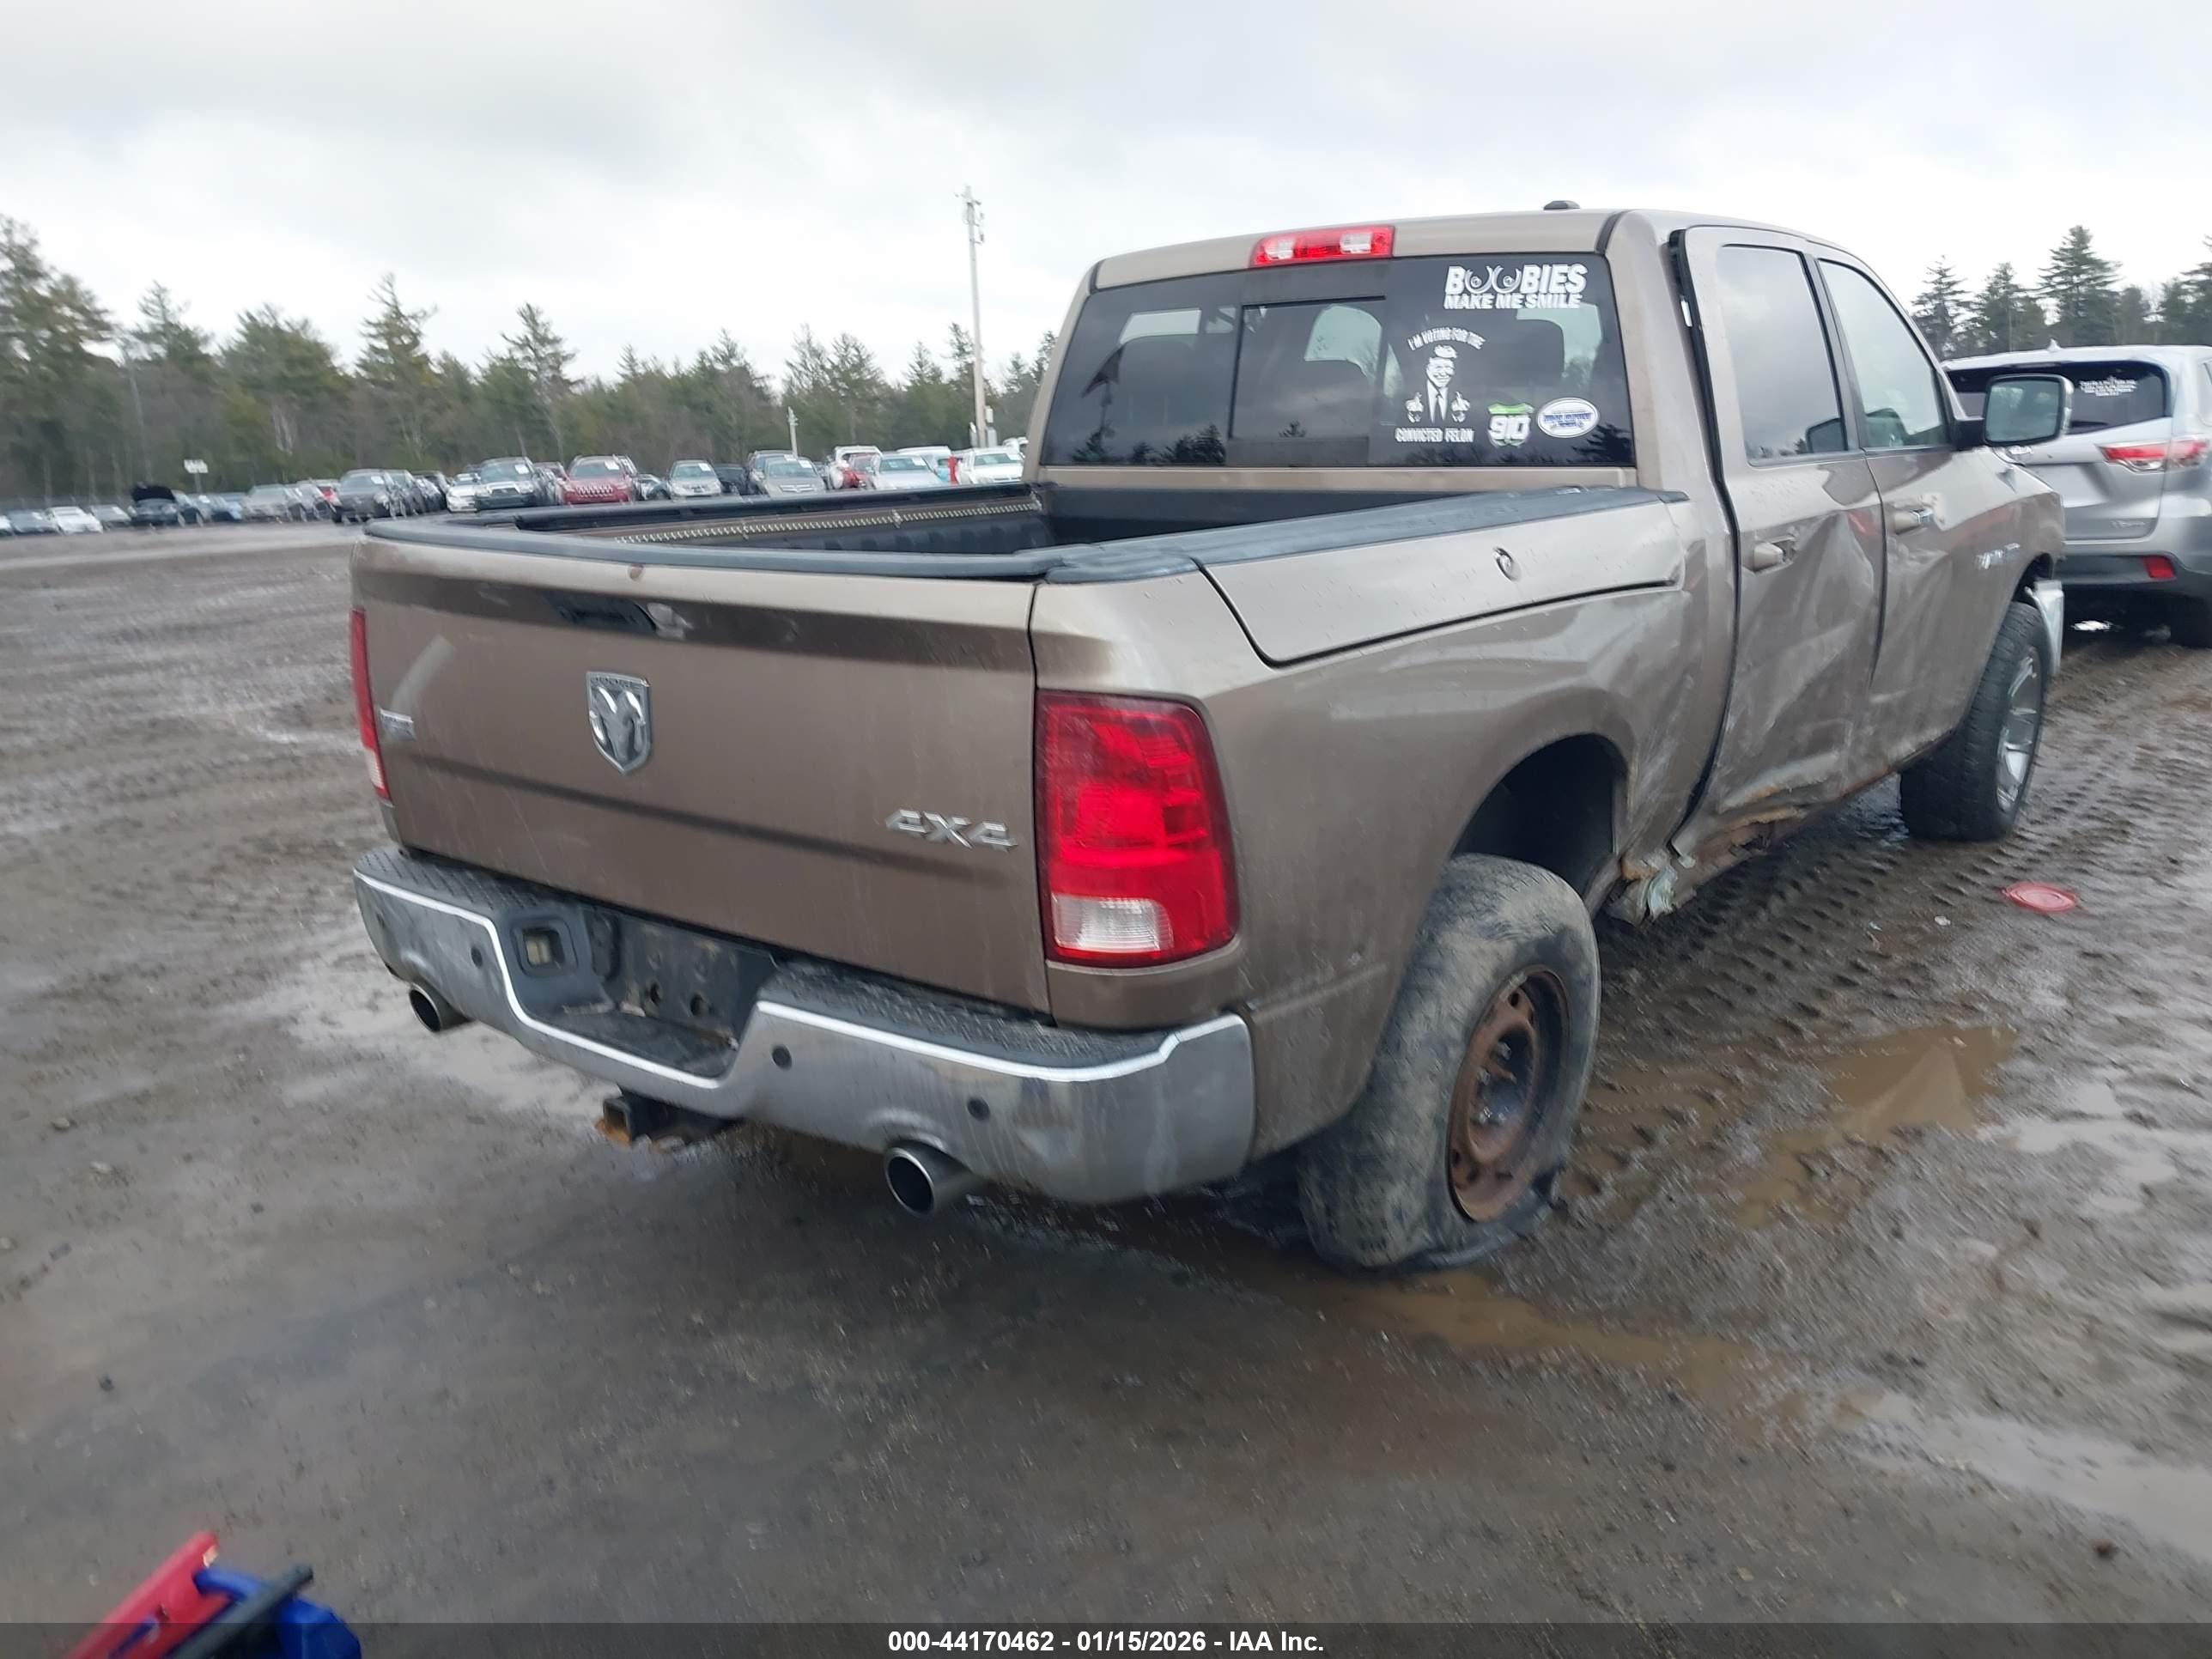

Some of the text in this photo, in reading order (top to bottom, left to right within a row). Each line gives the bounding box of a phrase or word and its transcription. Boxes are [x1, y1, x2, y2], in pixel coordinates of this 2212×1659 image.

[1443, 292, 1583, 310] MAKE ME SMILE
[1395, 427, 1474, 442] CONVICTED FELON
